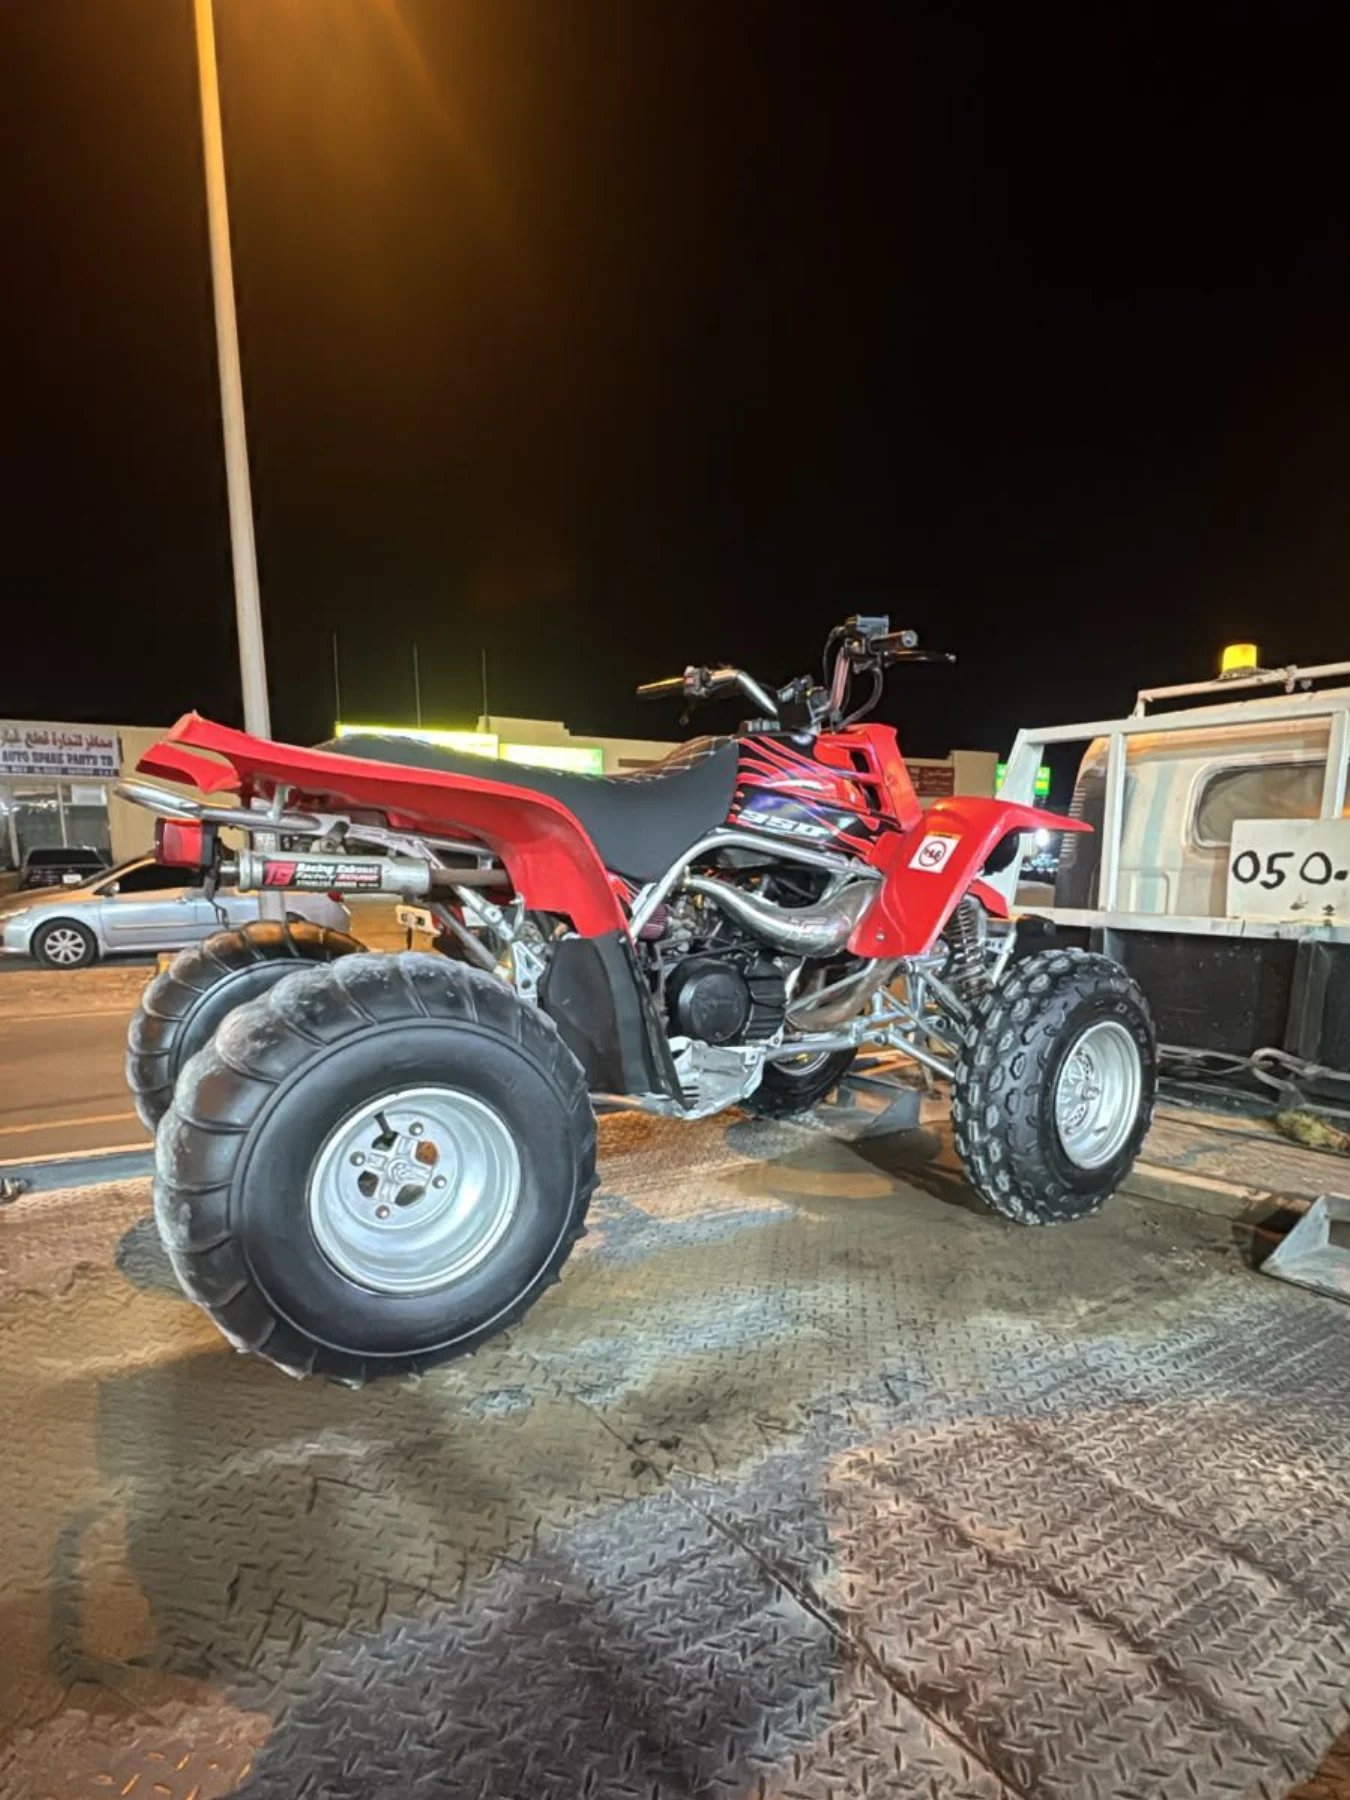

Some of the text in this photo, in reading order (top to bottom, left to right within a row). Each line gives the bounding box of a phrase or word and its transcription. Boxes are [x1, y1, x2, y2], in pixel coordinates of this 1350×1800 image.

[2, 750, 29, 763] AUTO
[31, 751, 65, 764] SPARE
[66, 753, 99, 766] PARTS
[297, 862, 336, 876] Racing
[295, 871, 336, 882] Factory
